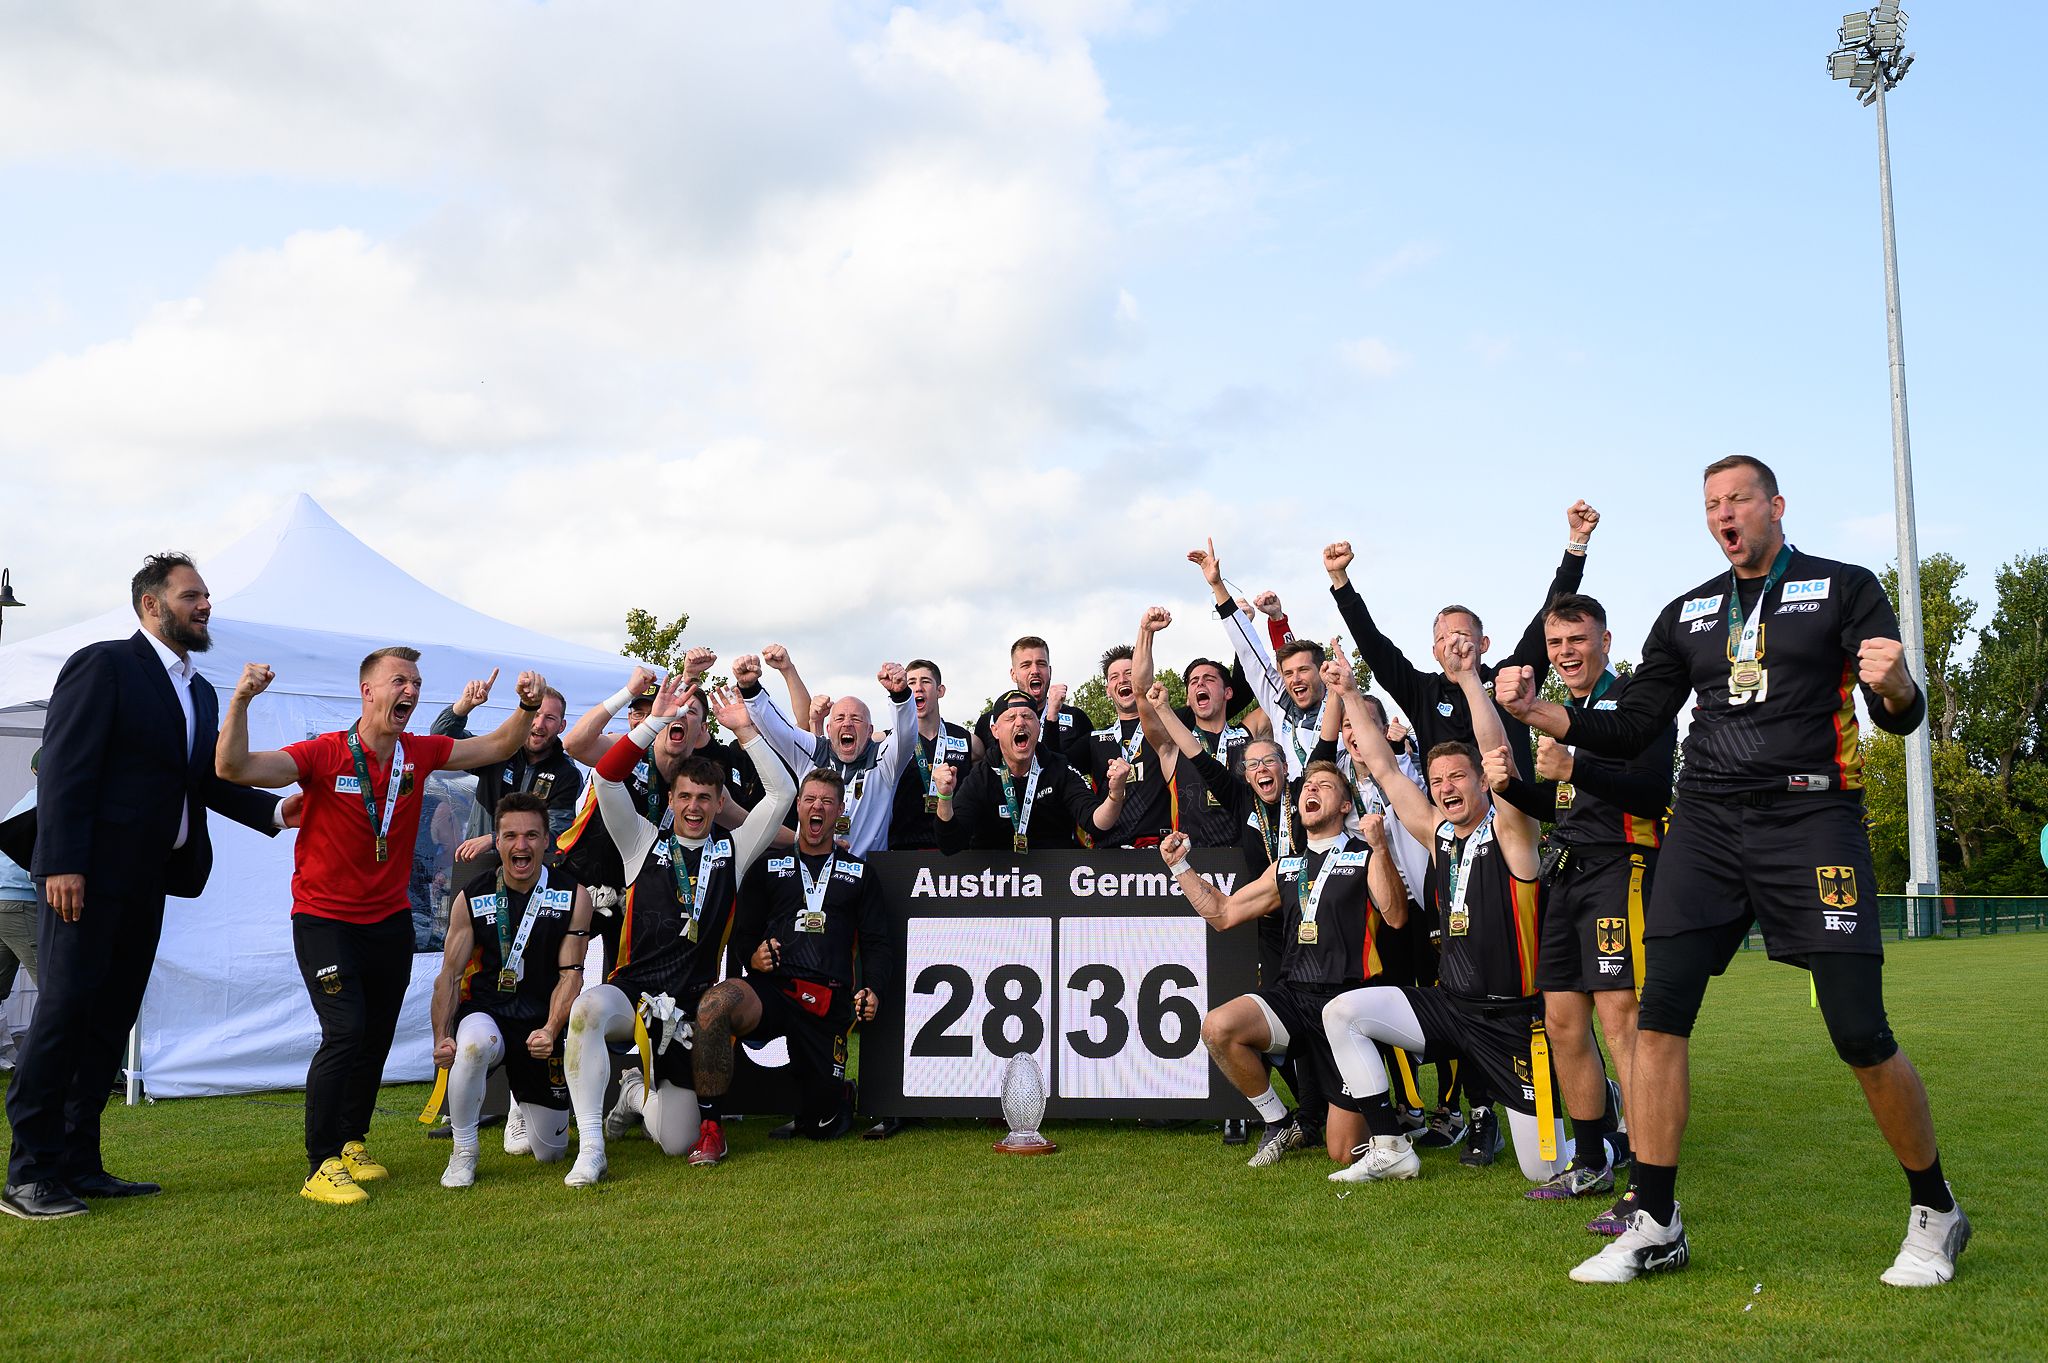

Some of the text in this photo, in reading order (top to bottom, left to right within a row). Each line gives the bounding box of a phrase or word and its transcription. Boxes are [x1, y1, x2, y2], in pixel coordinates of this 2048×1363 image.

[1787, 581, 1825, 594] DKB
[1685, 598, 1718, 613] DKB
[1778, 602, 1819, 613] AFVD
[947, 737, 966, 748] DKB
[1340, 853, 1365, 861] DKB
[837, 862, 862, 872] DKB
[910, 867, 1043, 898] Austria
[545, 890, 569, 903] DKB
[315, 964, 338, 978] AFVD
[909, 963, 1045, 1059] 28
[1065, 963, 1202, 1060] 36
